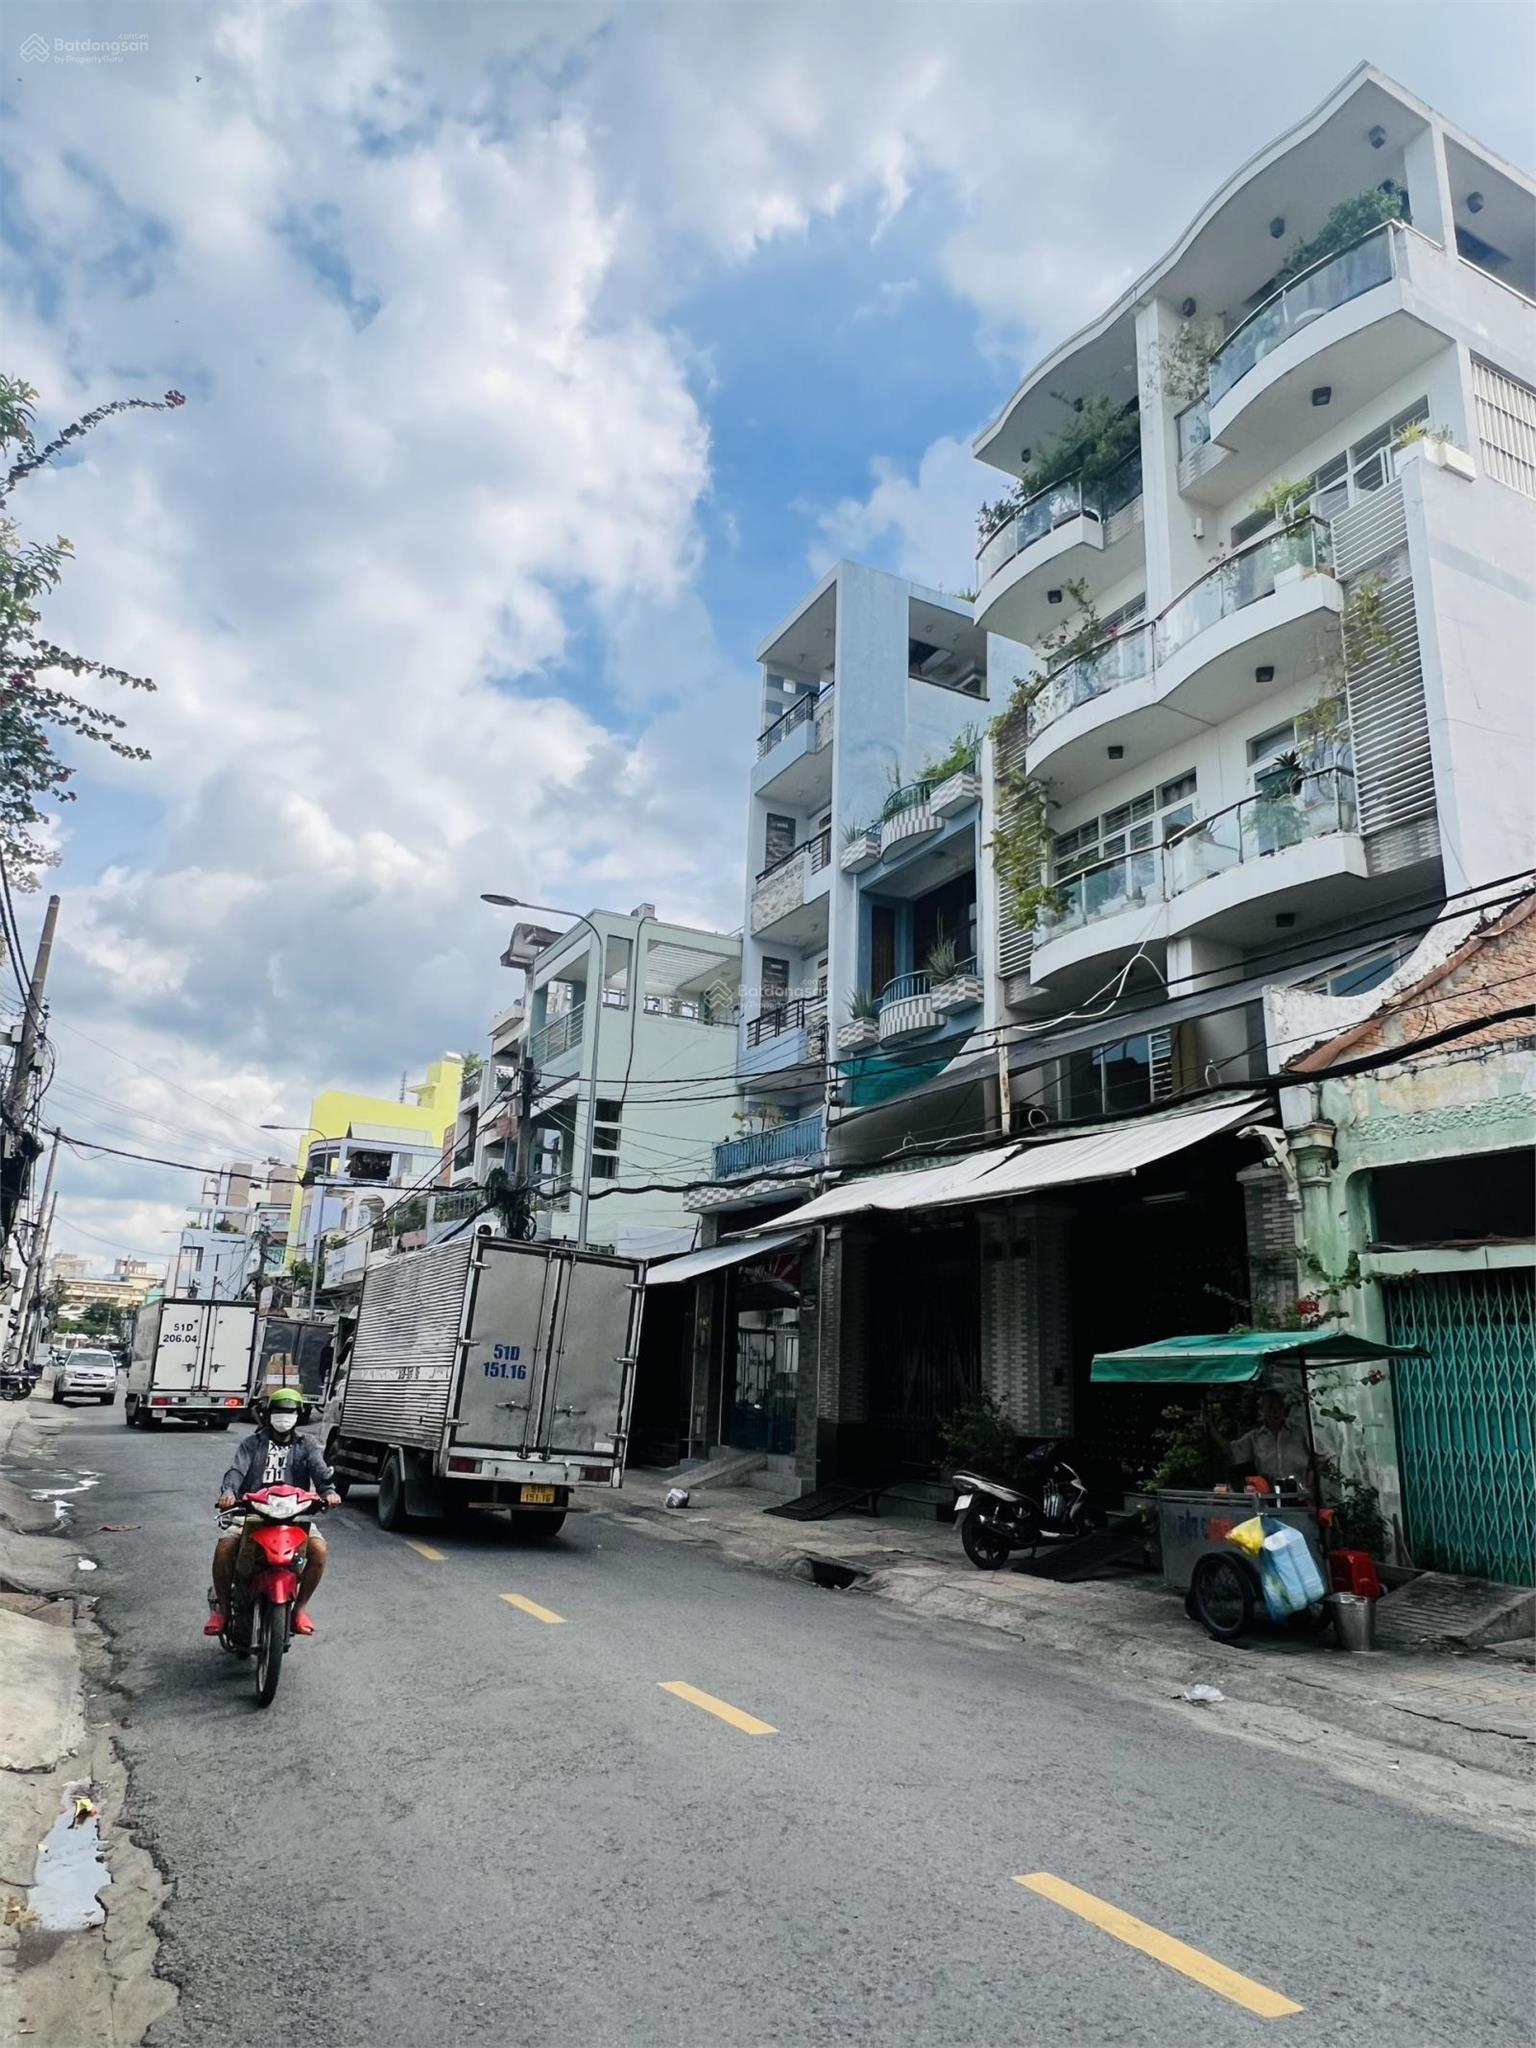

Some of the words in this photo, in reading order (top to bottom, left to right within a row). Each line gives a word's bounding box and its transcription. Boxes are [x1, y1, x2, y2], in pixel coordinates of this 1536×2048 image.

[173, 1323, 194, 1332] 51D
[163, 1334, 197, 1343] 206.04
[493, 1343, 521, 1361] 51D
[483, 1361, 527, 1380] 151.16
